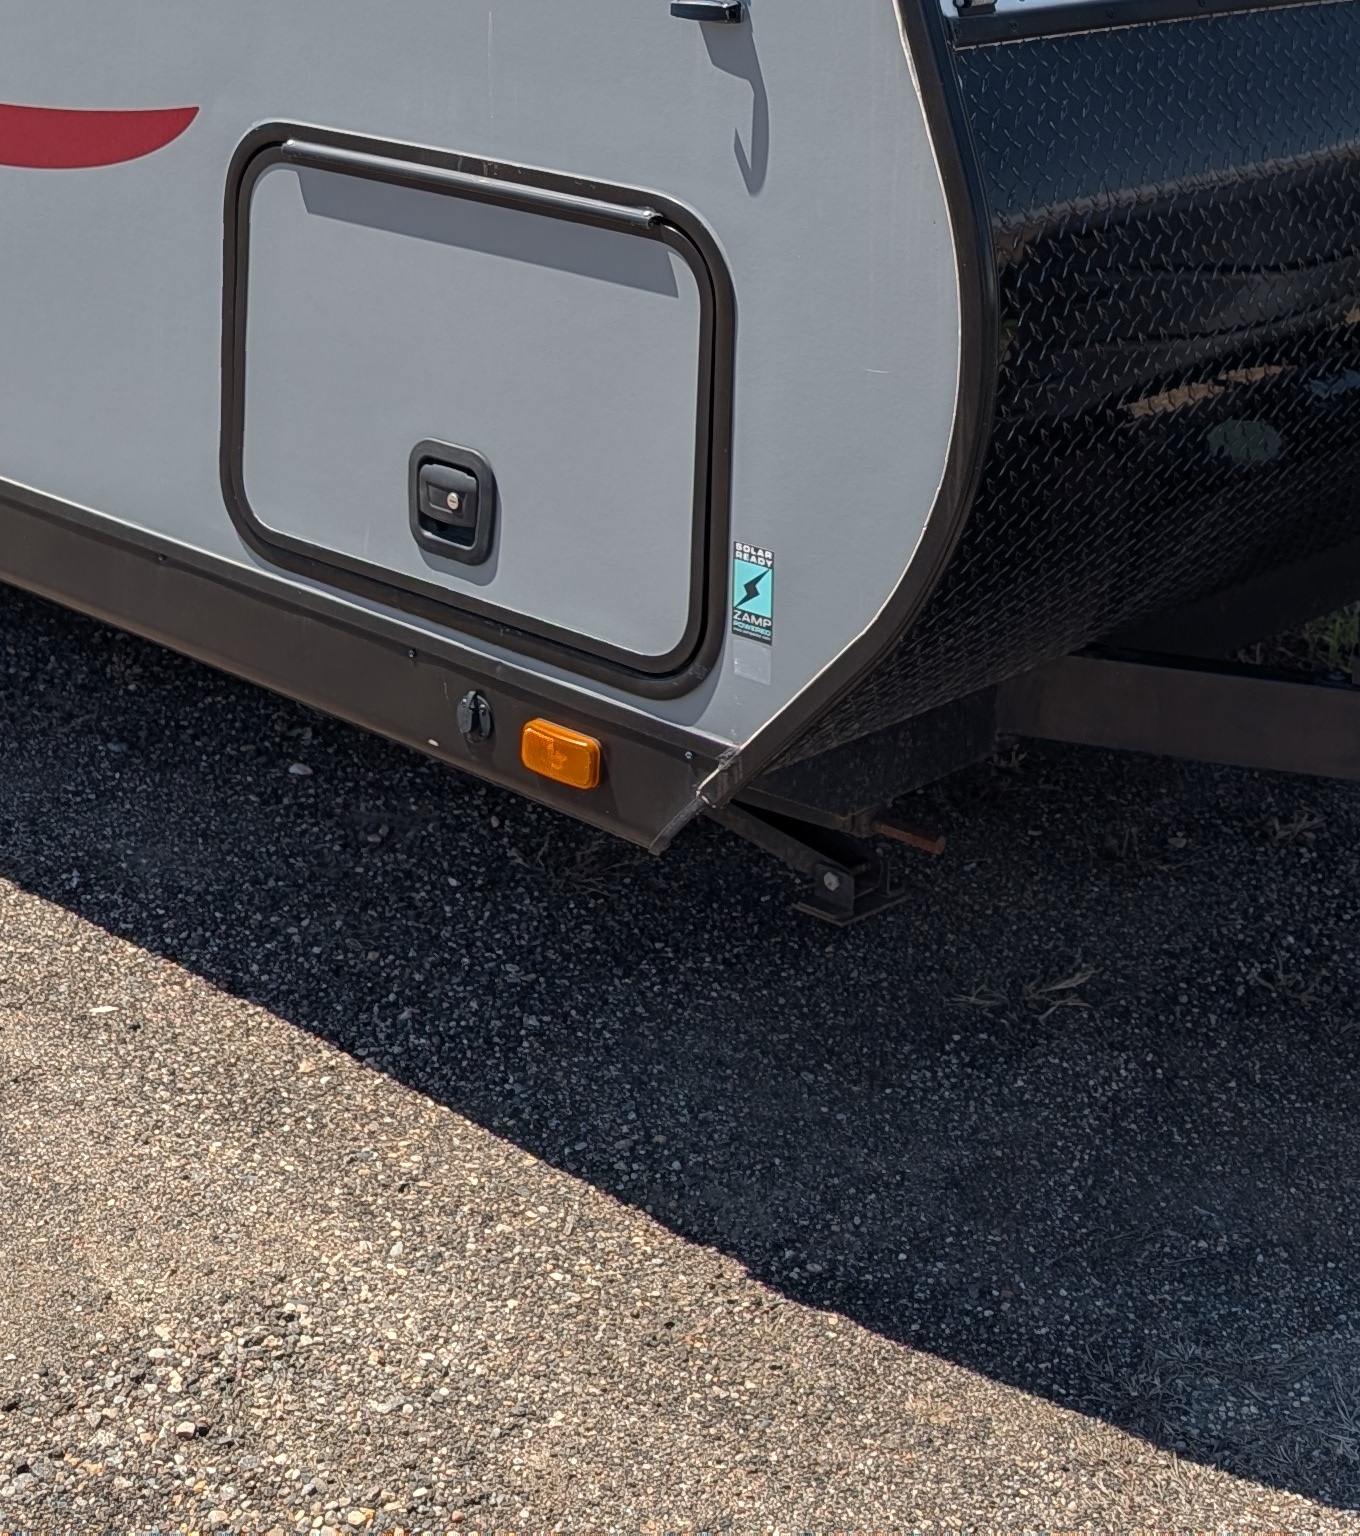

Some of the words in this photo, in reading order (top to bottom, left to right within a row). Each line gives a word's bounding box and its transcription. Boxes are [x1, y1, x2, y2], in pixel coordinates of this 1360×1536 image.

[735, 543, 773, 559] SOLAR
[735, 551, 773, 568] READY
[733, 610, 772, 627] ZAMP
